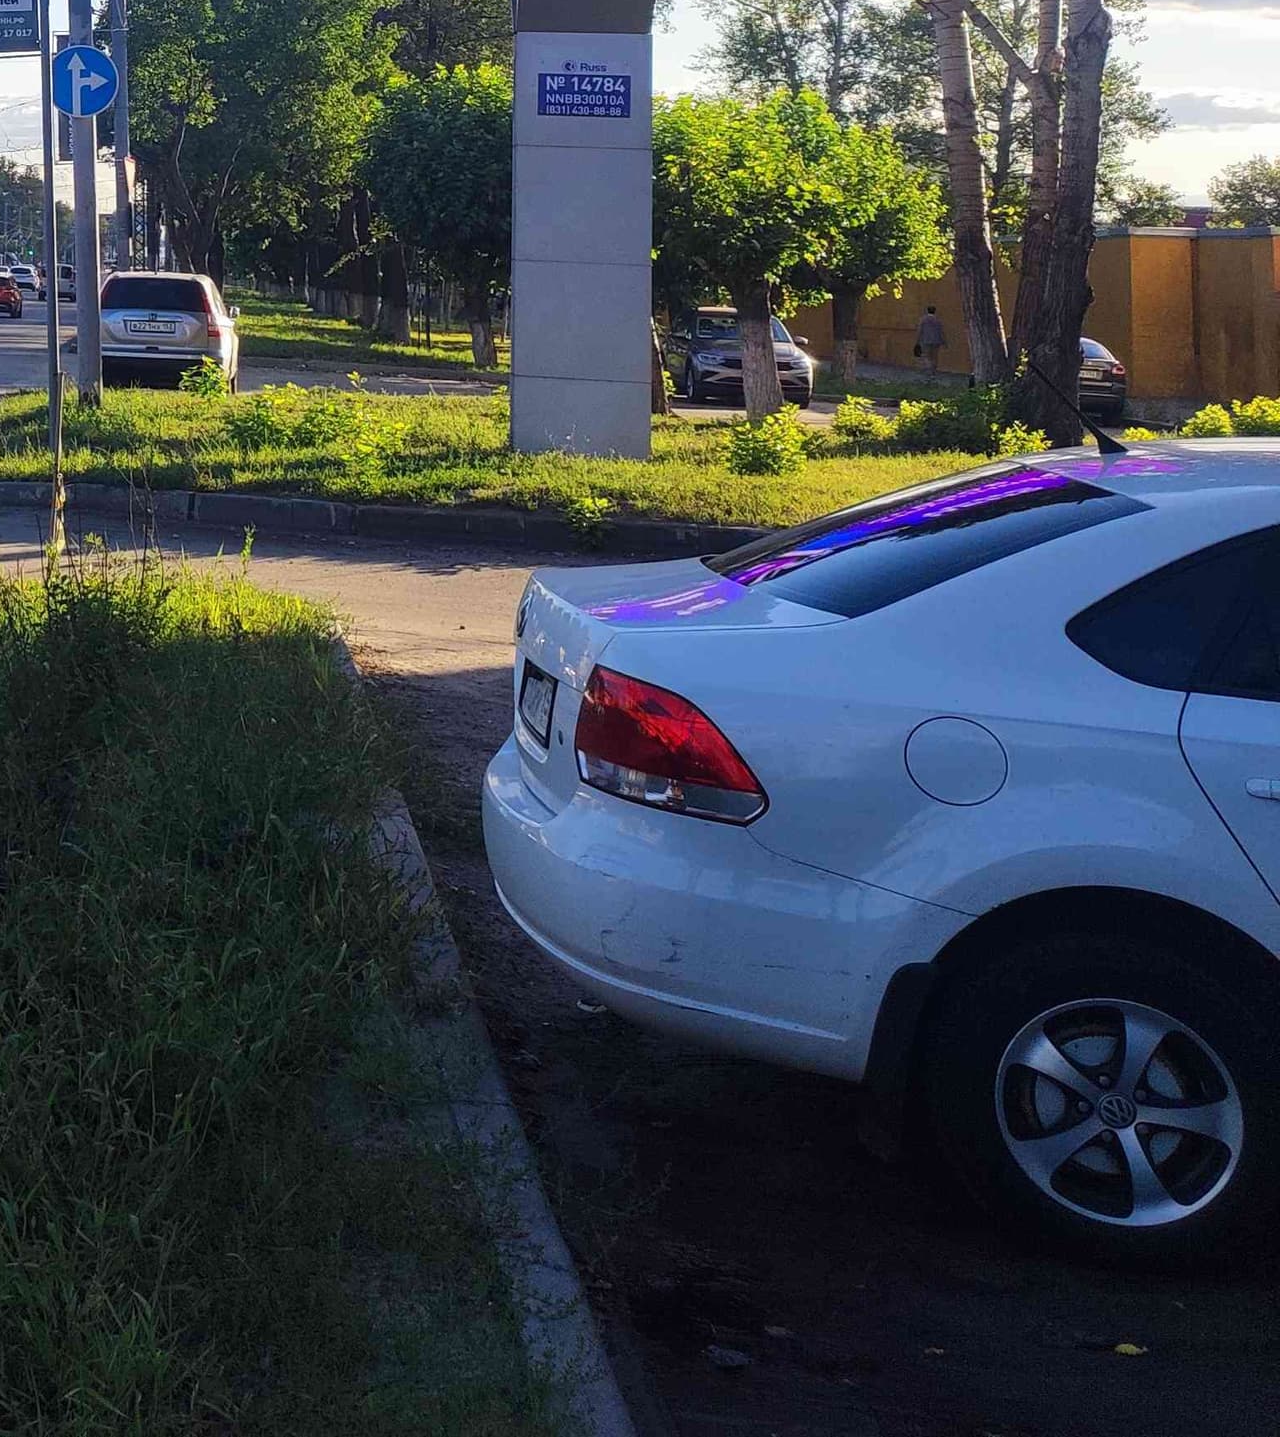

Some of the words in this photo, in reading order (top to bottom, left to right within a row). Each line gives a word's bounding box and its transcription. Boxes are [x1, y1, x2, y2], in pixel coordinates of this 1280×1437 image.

[3, 29, 14, 38] 17
[16, 28, 33, 37] 017
[570, 77, 626, 93] 14784
